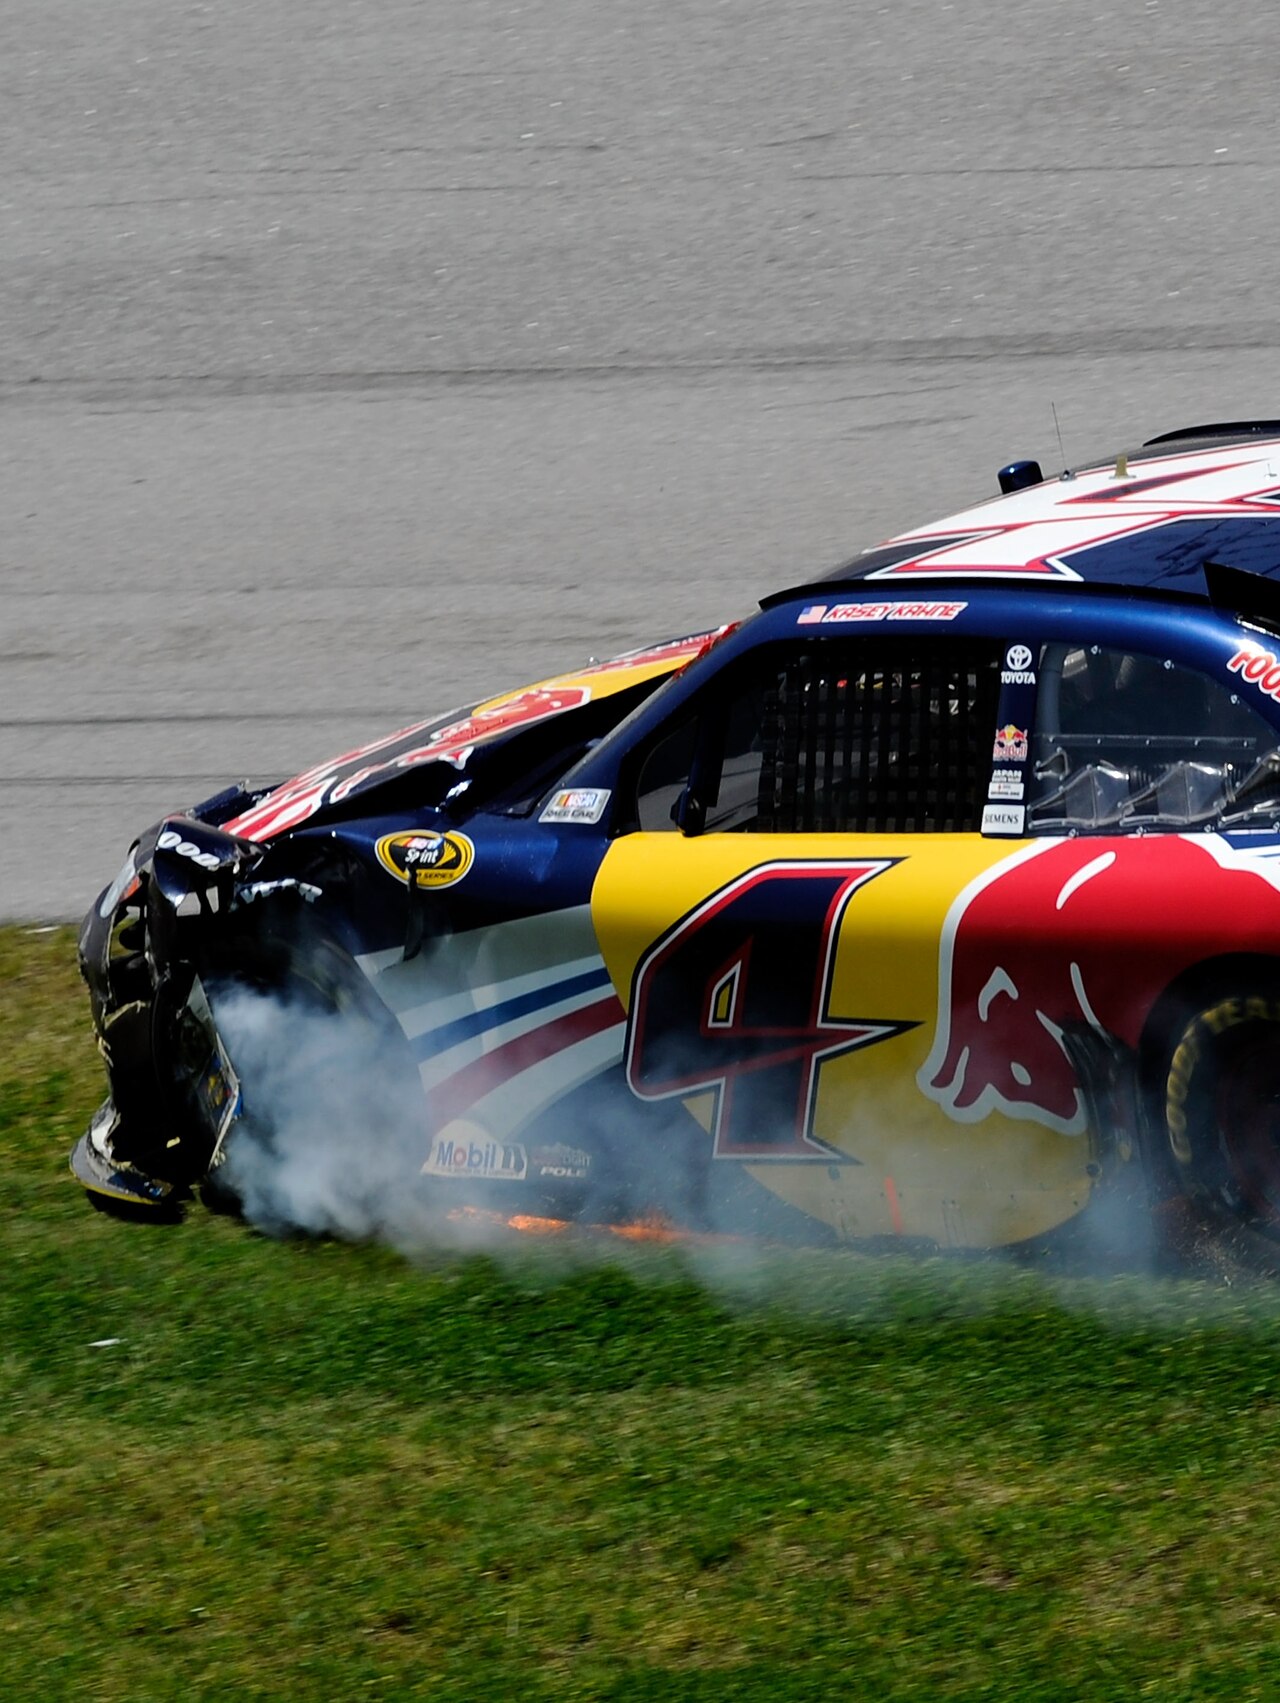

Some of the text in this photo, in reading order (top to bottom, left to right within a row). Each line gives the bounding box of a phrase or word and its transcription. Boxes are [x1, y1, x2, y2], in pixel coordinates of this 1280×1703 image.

[827, 602, 965, 620] KASEY KAHNE
[1001, 671, 1036, 685] TOYOTA
[572, 809, 594, 818] CAR
[984, 813, 1020, 825] SIEMENS
[405, 848, 439, 863] Spint
[624, 857, 924, 1165] 4
[436, 1141, 496, 1169] Mobil
[540, 1166, 587, 1178] POLE
